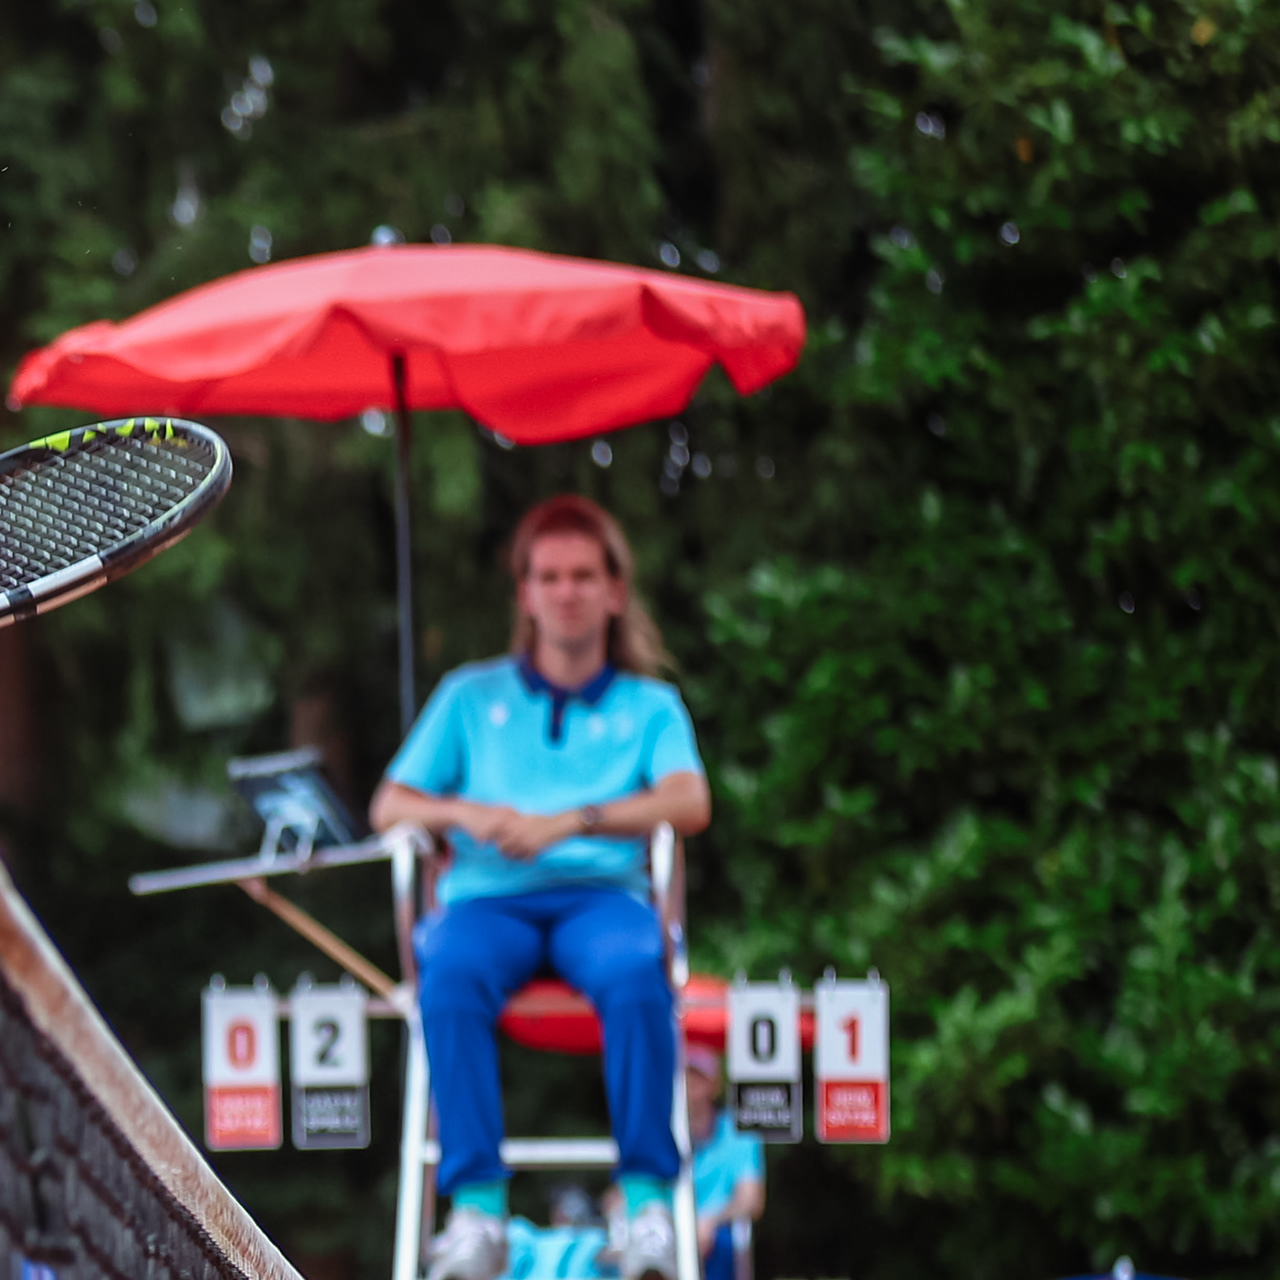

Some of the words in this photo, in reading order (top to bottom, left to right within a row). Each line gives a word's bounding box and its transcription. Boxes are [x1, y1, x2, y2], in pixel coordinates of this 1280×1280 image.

[226, 1019, 257, 1070] 0
[314, 1019, 341, 1067] 2
[750, 1015, 776, 1064] 0
[840, 1015, 860, 1064] 1
